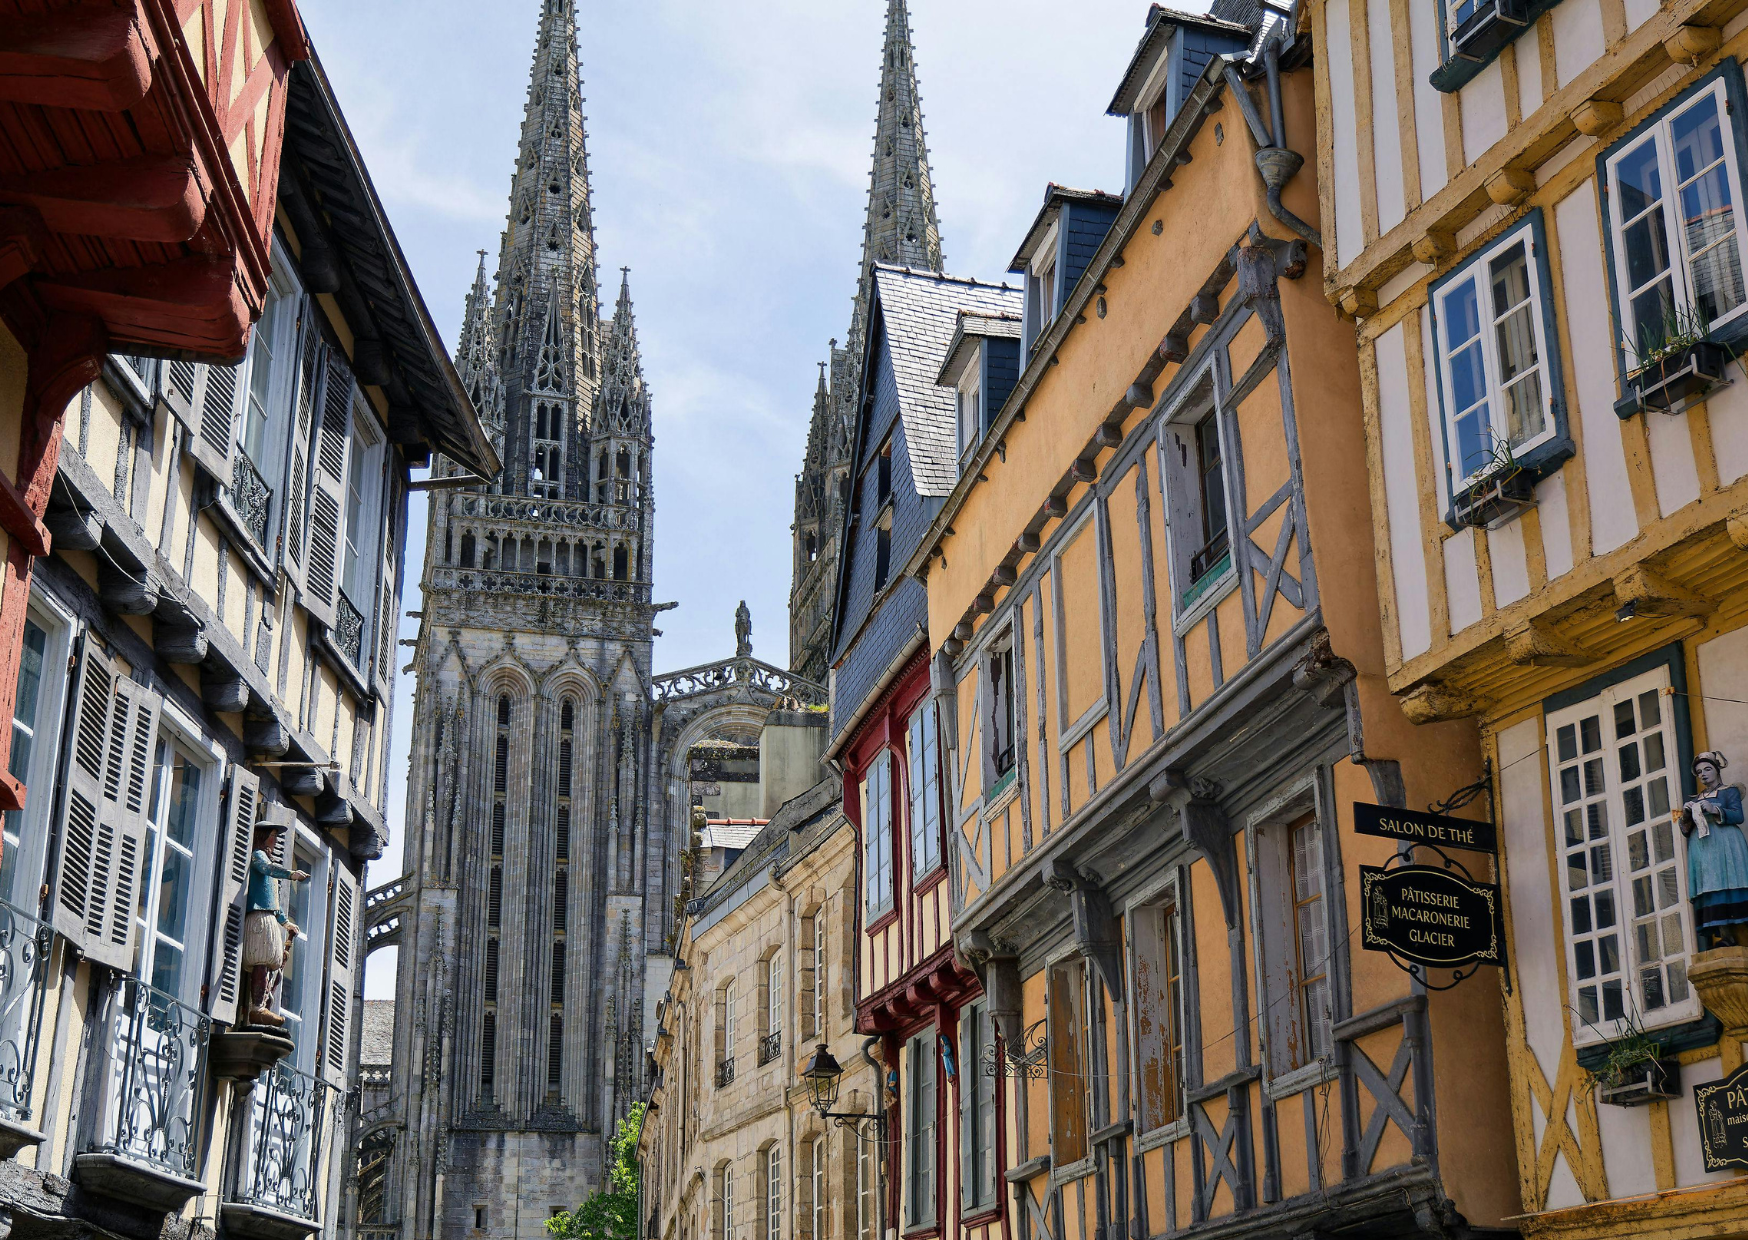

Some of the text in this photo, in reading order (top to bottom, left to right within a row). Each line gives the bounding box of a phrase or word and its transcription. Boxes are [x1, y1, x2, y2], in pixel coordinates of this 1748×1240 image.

[1379, 818, 1474, 843] SALON DE THÉ
[1401, 887, 1460, 909] PÂTISSERIE
[1391, 905, 1470, 929] MACARONERIE
[1409, 929, 1455, 947] GLACIER
